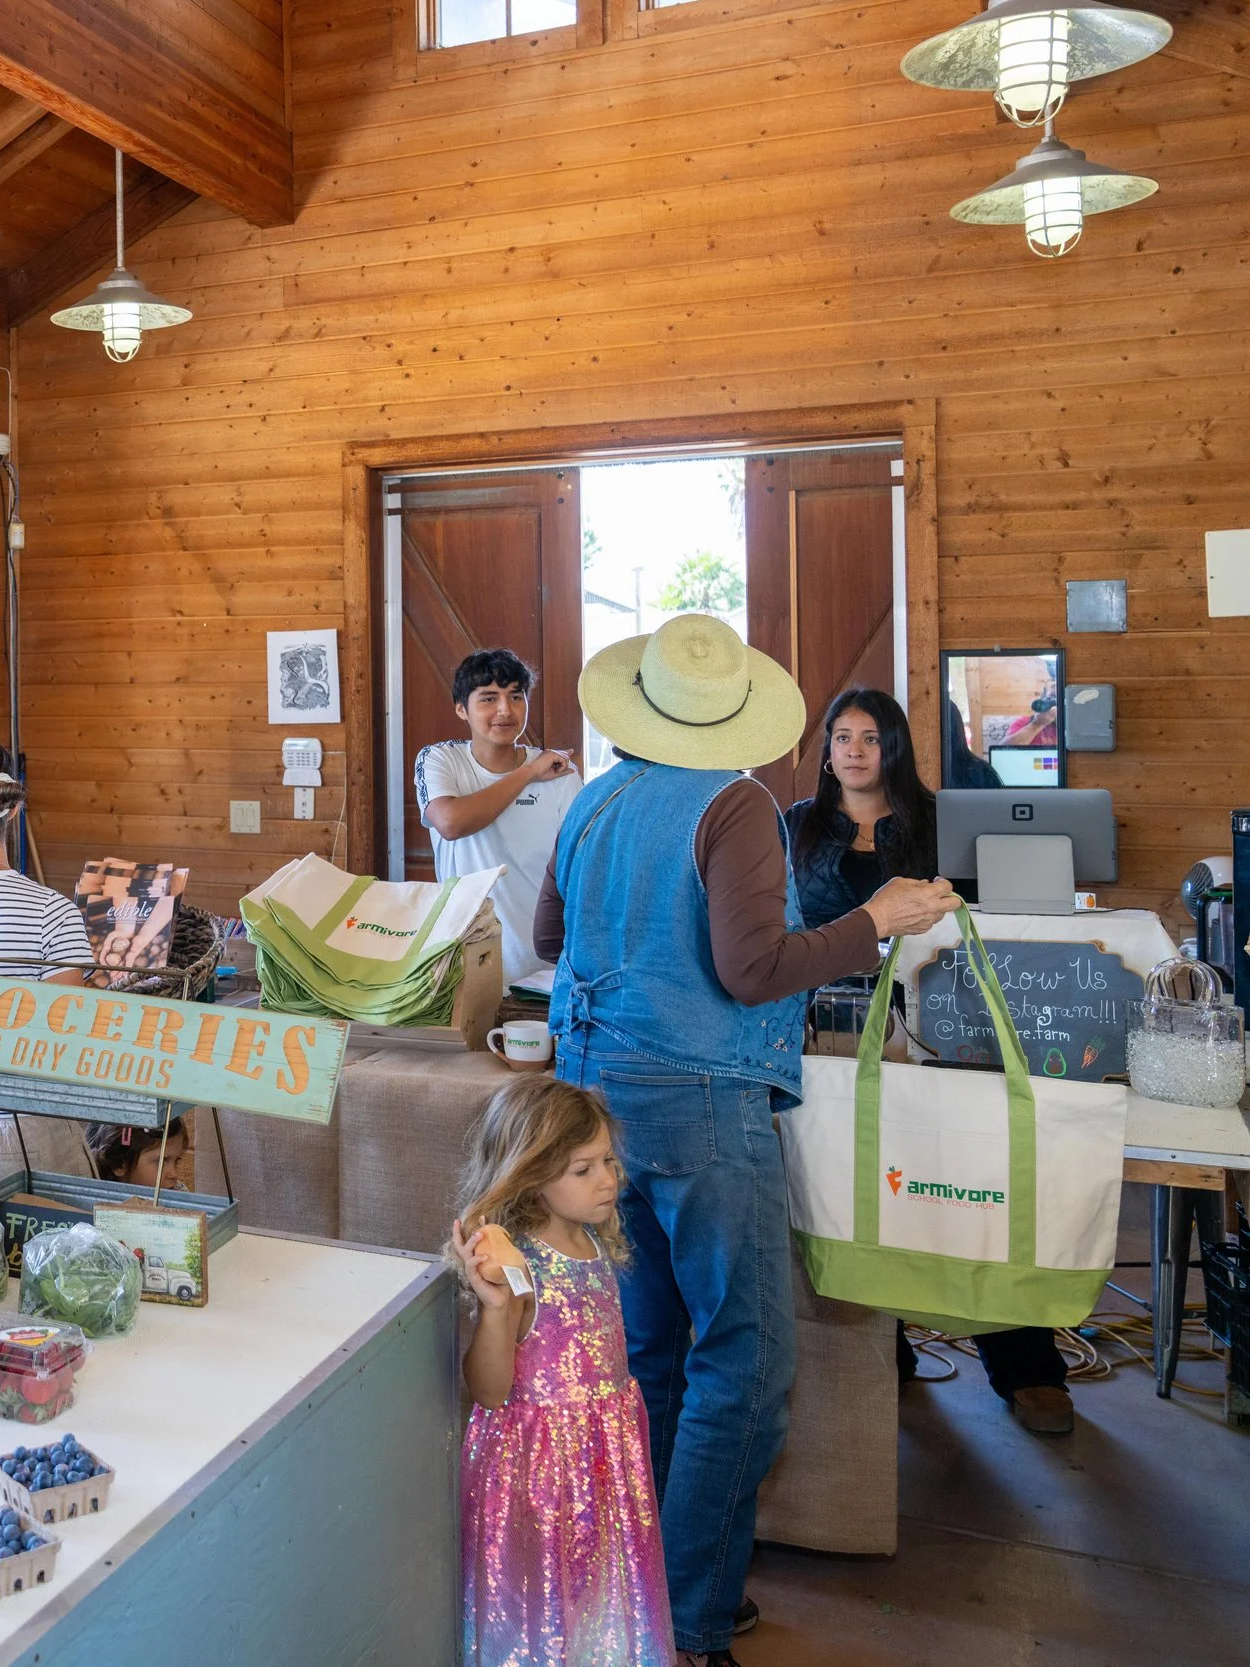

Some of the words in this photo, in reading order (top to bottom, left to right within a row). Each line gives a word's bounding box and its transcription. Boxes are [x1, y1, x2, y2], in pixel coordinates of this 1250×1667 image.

[106, 900, 153, 918] edible
[1069, 956, 1108, 991] Us
[926, 992, 960, 1015] on
[11, 1037, 67, 1072] DRY
[76, 1046, 175, 1090] GOODS
[907, 1194, 943, 1205] SCHOOL
[947, 1199, 971, 1209] FOOD
